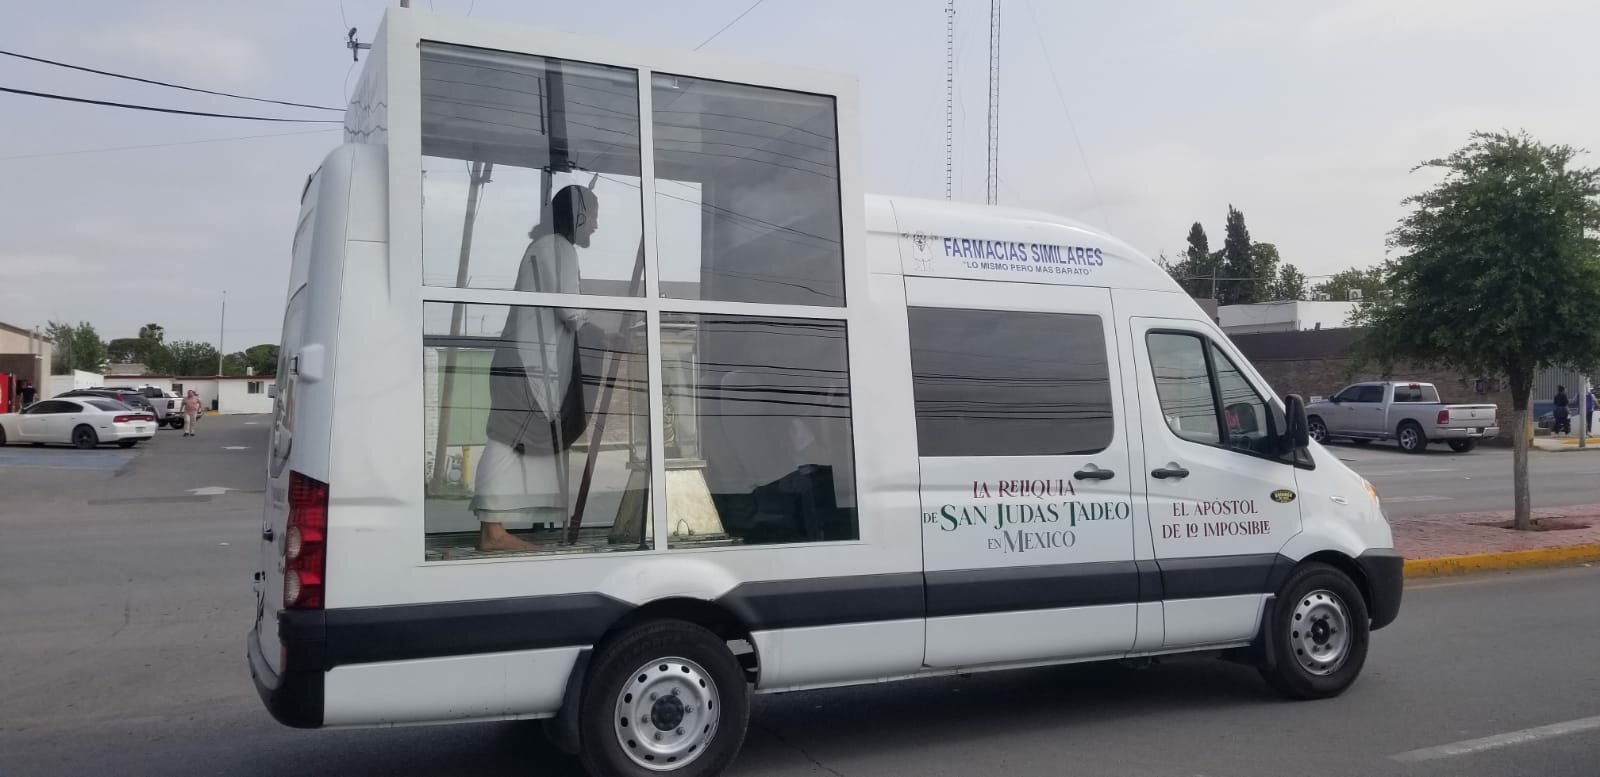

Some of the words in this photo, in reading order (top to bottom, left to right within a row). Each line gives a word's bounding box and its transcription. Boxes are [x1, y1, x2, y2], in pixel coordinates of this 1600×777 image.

[944, 237, 1027, 262] FARMACIAS
[1032, 243, 1103, 267] SIMILARES
[980, 262, 1008, 271] MISMO
[1011, 264, 1033, 272] PERO
[1036, 265, 1053, 274] MAS
[973, 480, 991, 498] LA
[999, 479, 1075, 500] RELIQUIA
[924, 512, 938, 524] DE
[940, 504, 987, 532] SAN
[994, 503, 1059, 530] JUDAS
[1063, 501, 1130, 527] TADEO
[1173, 502, 1189, 516] EL
[1162, 523, 1181, 539] DE
[1186, 523, 1198, 538] LO
[1204, 520, 1271, 537] IMPOSIBLE
[987, 538, 1002, 550] EN
